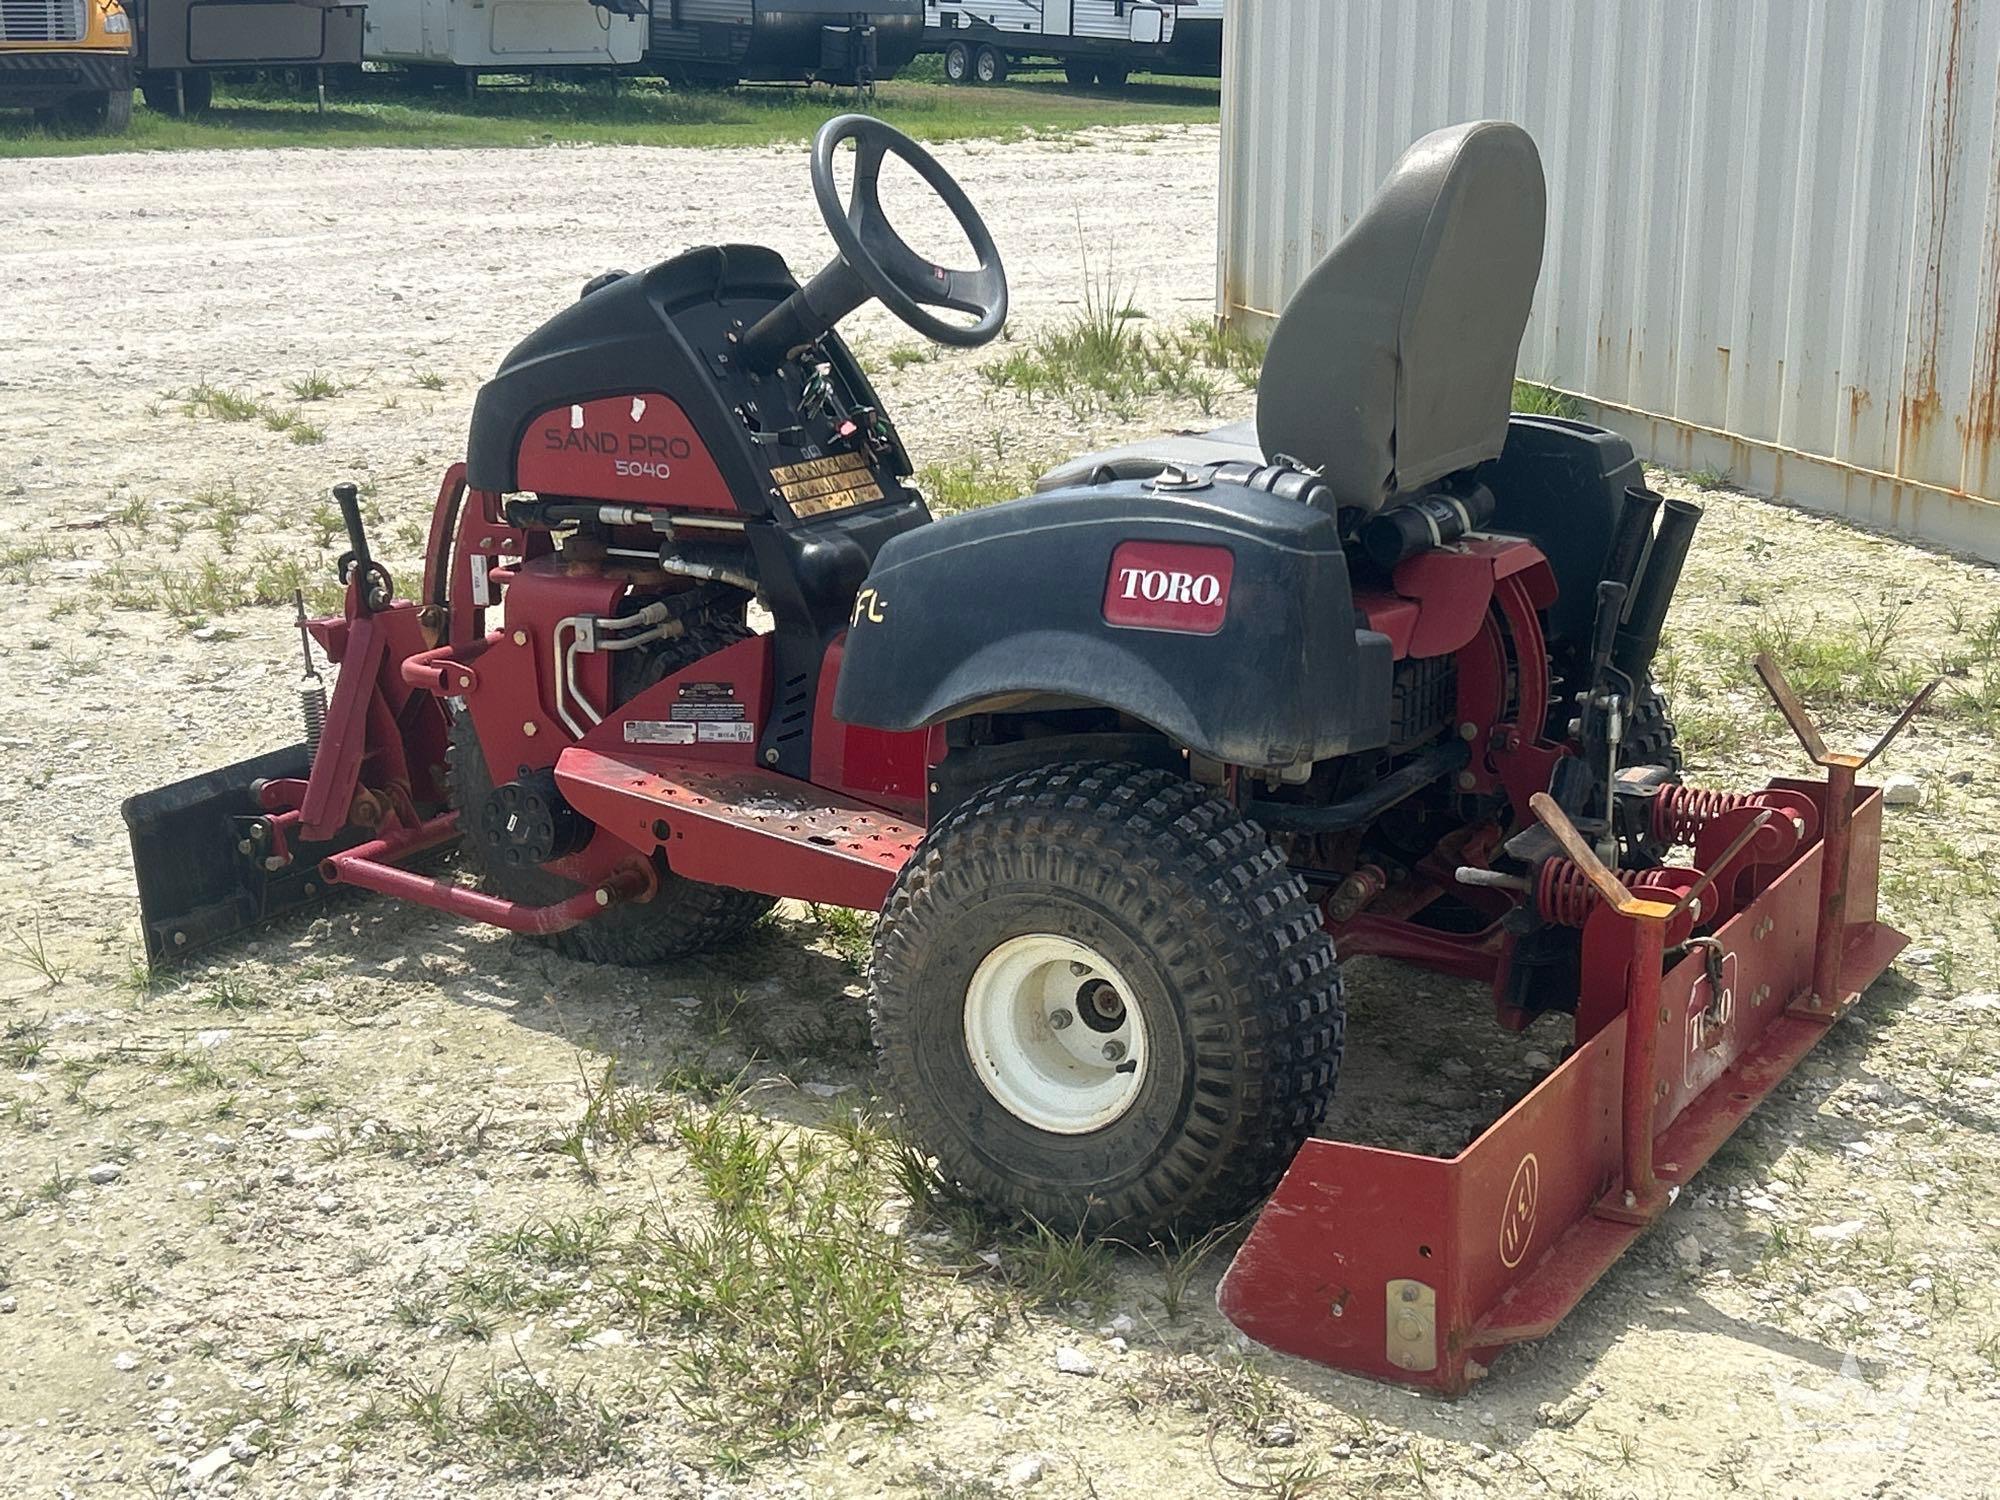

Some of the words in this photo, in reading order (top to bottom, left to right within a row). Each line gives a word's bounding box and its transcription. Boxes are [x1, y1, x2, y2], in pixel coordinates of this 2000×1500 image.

[545, 428, 619, 454] SAND
[628, 433, 691, 459] PRO
[615, 460, 671, 479] 5040
[1119, 568, 1221, 606] TORO
